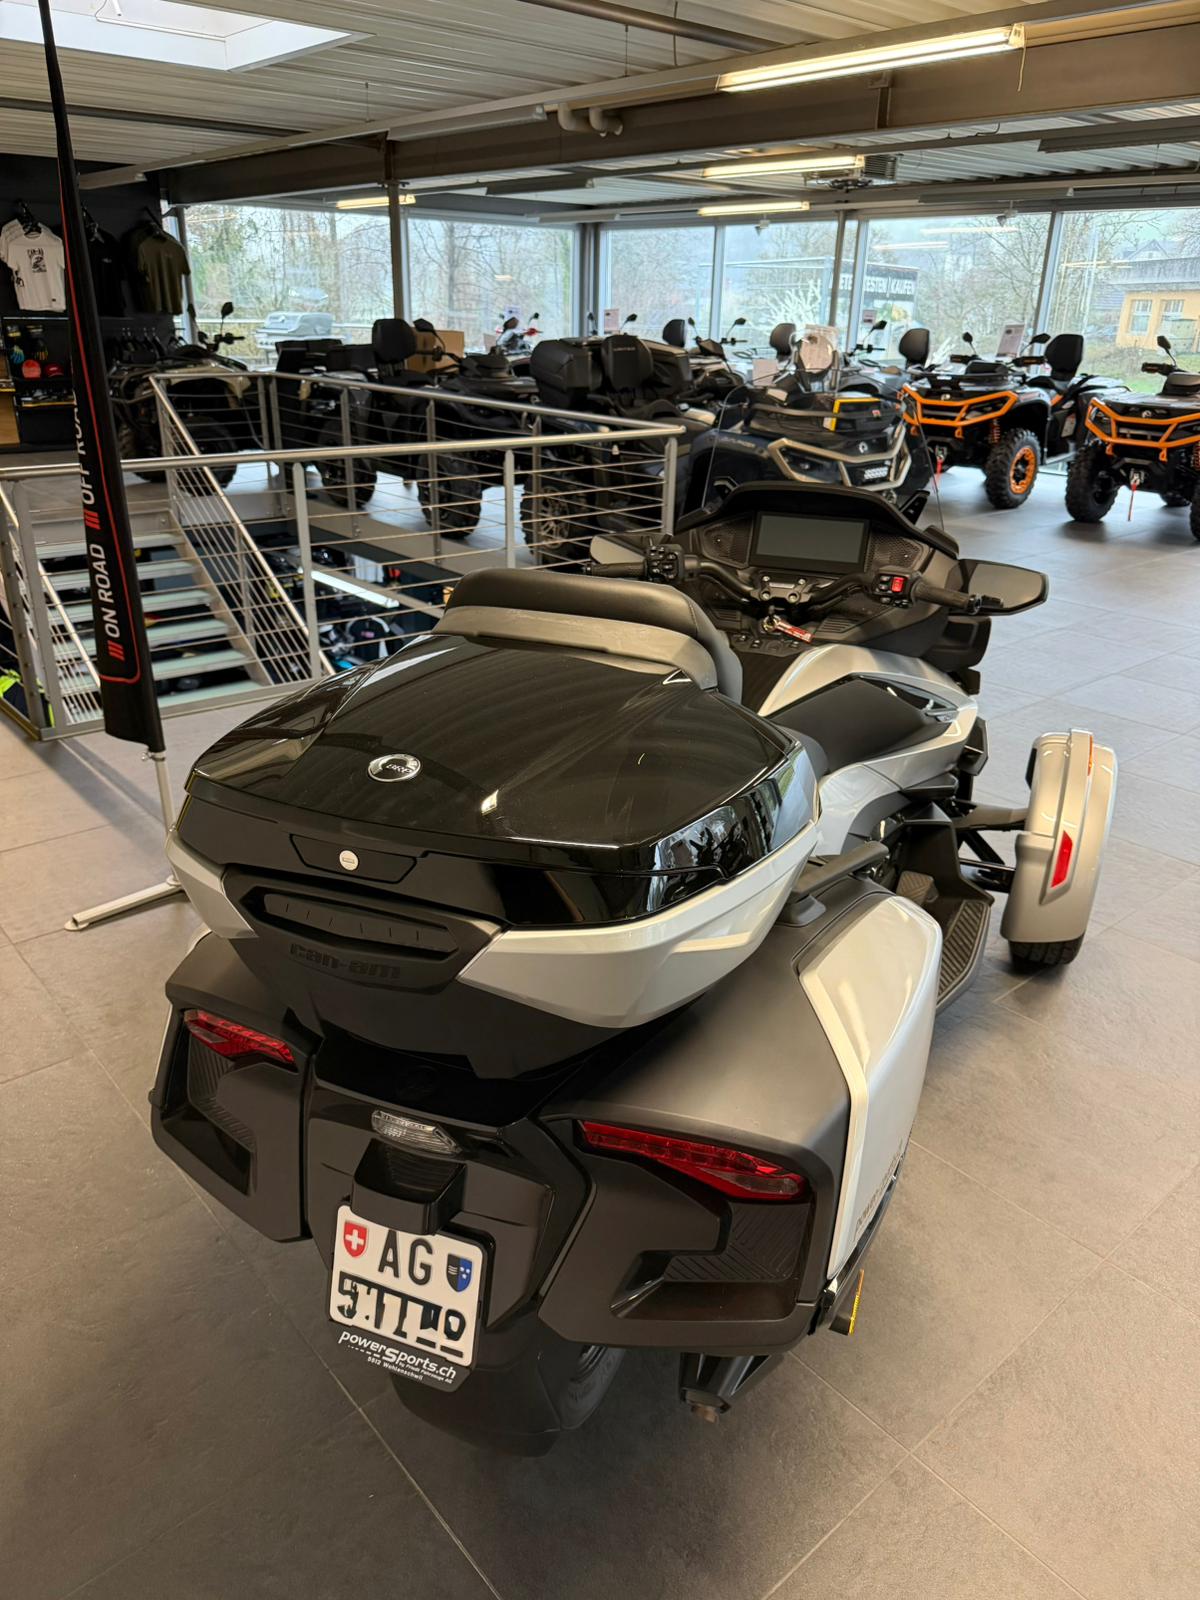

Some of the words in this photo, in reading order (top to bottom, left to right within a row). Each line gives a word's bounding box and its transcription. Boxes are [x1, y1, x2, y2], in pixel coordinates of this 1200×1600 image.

[89, 543, 114, 603] ROAD
[101, 607, 120, 638] ON
[378, 1230, 433, 1286] AG
